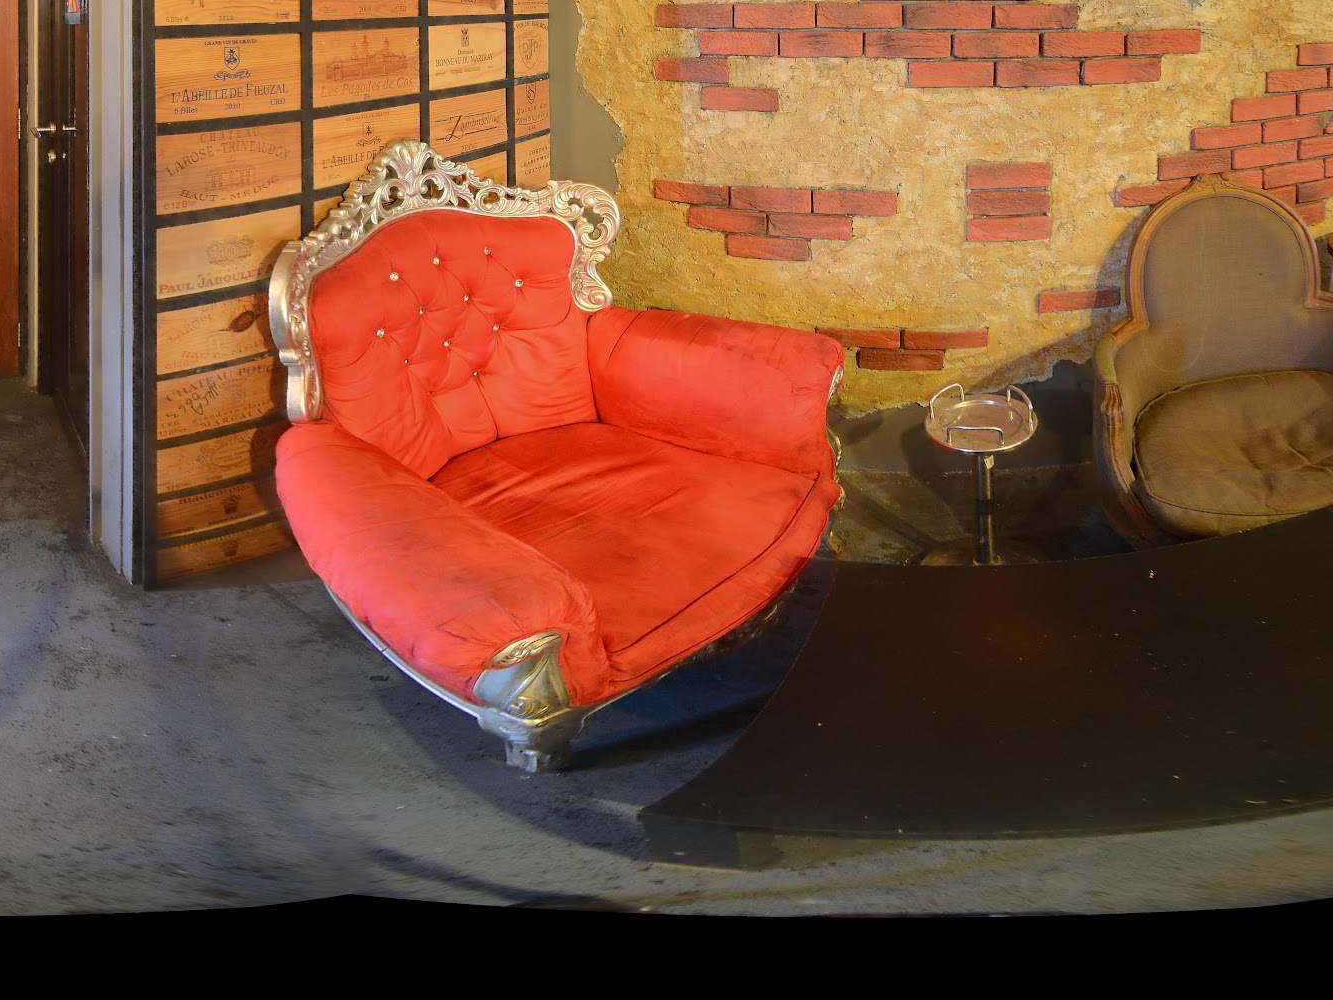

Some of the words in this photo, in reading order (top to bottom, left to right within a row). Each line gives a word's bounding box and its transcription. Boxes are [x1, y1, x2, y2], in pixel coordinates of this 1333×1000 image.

[435, 57, 462, 67] BONNEAU
[463, 56, 471, 65] DU
[471, 53, 494, 64] MARTRAY
[171, 88, 227, 104] L'ABEILLE
[229, 87, 243, 98] DE
[246, 83, 288, 97] FIEUZAL
[321, 86, 339, 98] Les
[342, 80, 381, 95] Pagodes
[383, 78, 394, 89] de
[396, 77, 413, 88] Cos
[224, 102, 241, 111] 2010
[270, 98, 286, 106] CRD
[200, 127, 259, 143] CHATEAU
[323, 151, 365, 169] L'ABEILLE
[367, 150, 377, 160] DE
[158, 282, 195, 294] PAUL
[197, 267, 264, 288] JABOULET
[166, 372, 233, 401] CHATEAU
